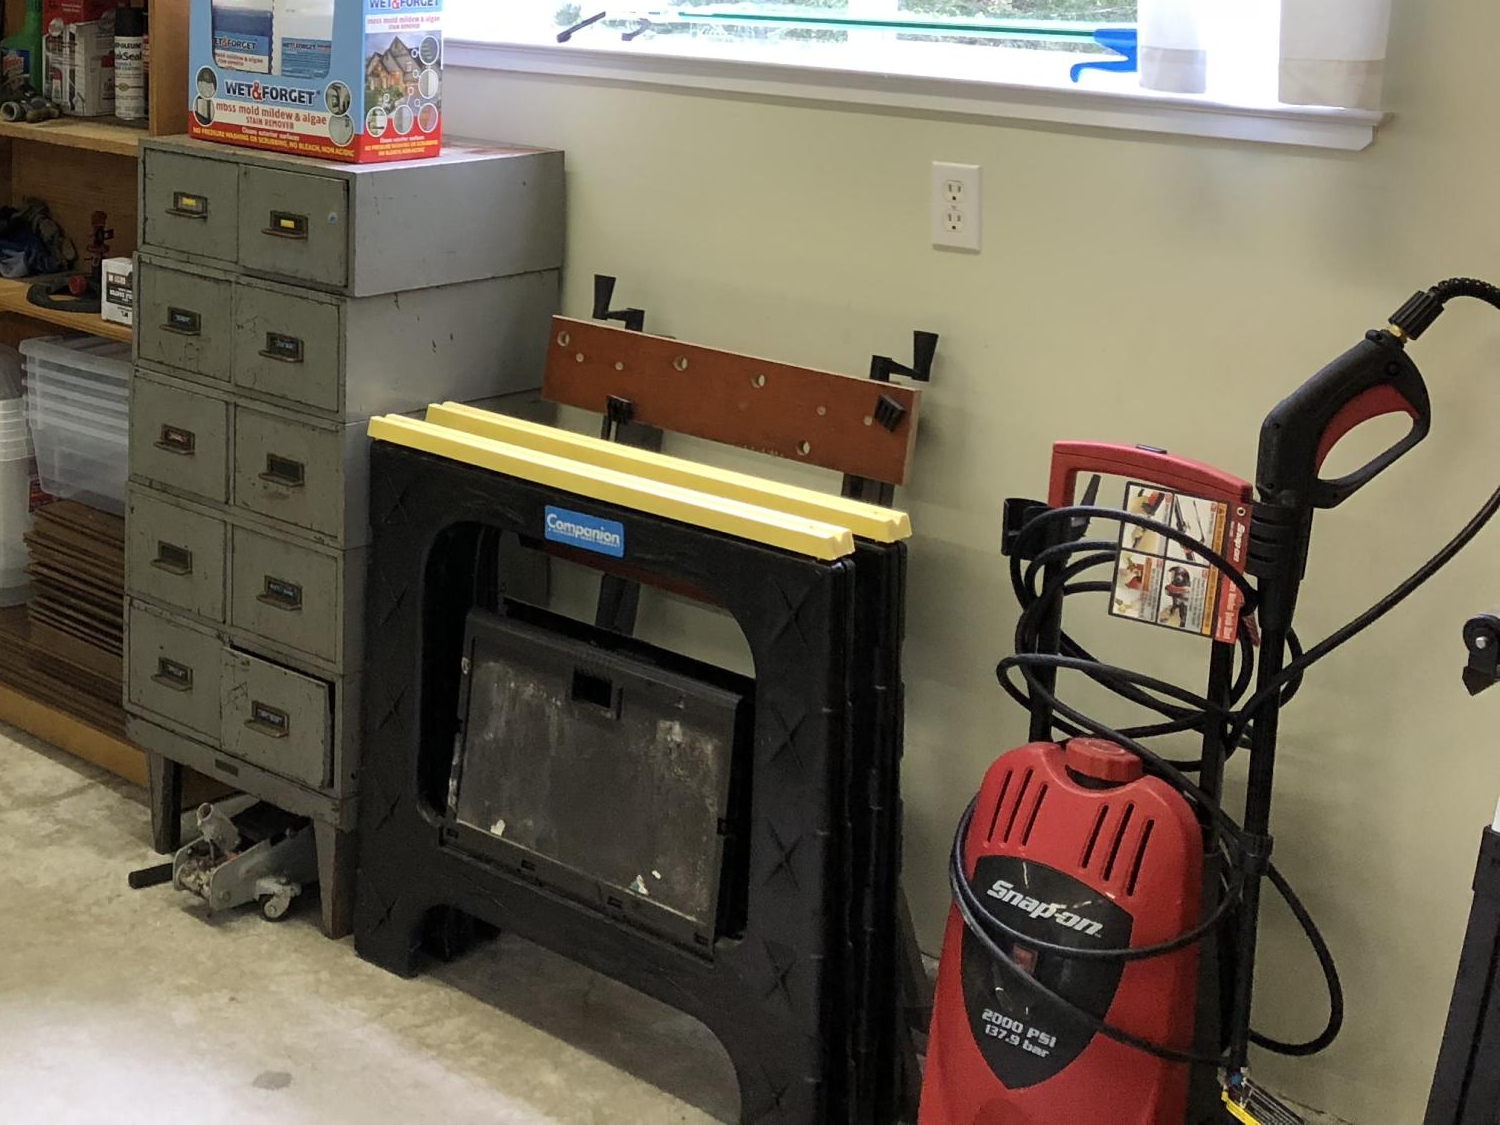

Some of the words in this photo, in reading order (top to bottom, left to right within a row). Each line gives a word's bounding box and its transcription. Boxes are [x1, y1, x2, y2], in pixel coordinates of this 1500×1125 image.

[216, 102, 236, 113] moss
[239, 104, 259, 116] mold
[261, 106, 293, 121] mildew
[294, 113, 301, 121] &
[302, 113, 327, 126] algae
[265, 118, 294, 130] REMOVER
[546, 513, 620, 545] Companion
[987, 880, 1104, 936] Snap-on
[981, 1008, 1024, 1034] 2000
[1026, 1027, 1057, 1049] PSI
[985, 1024, 1020, 1047] 137.9
[1022, 1038, 1050, 1058] bar
